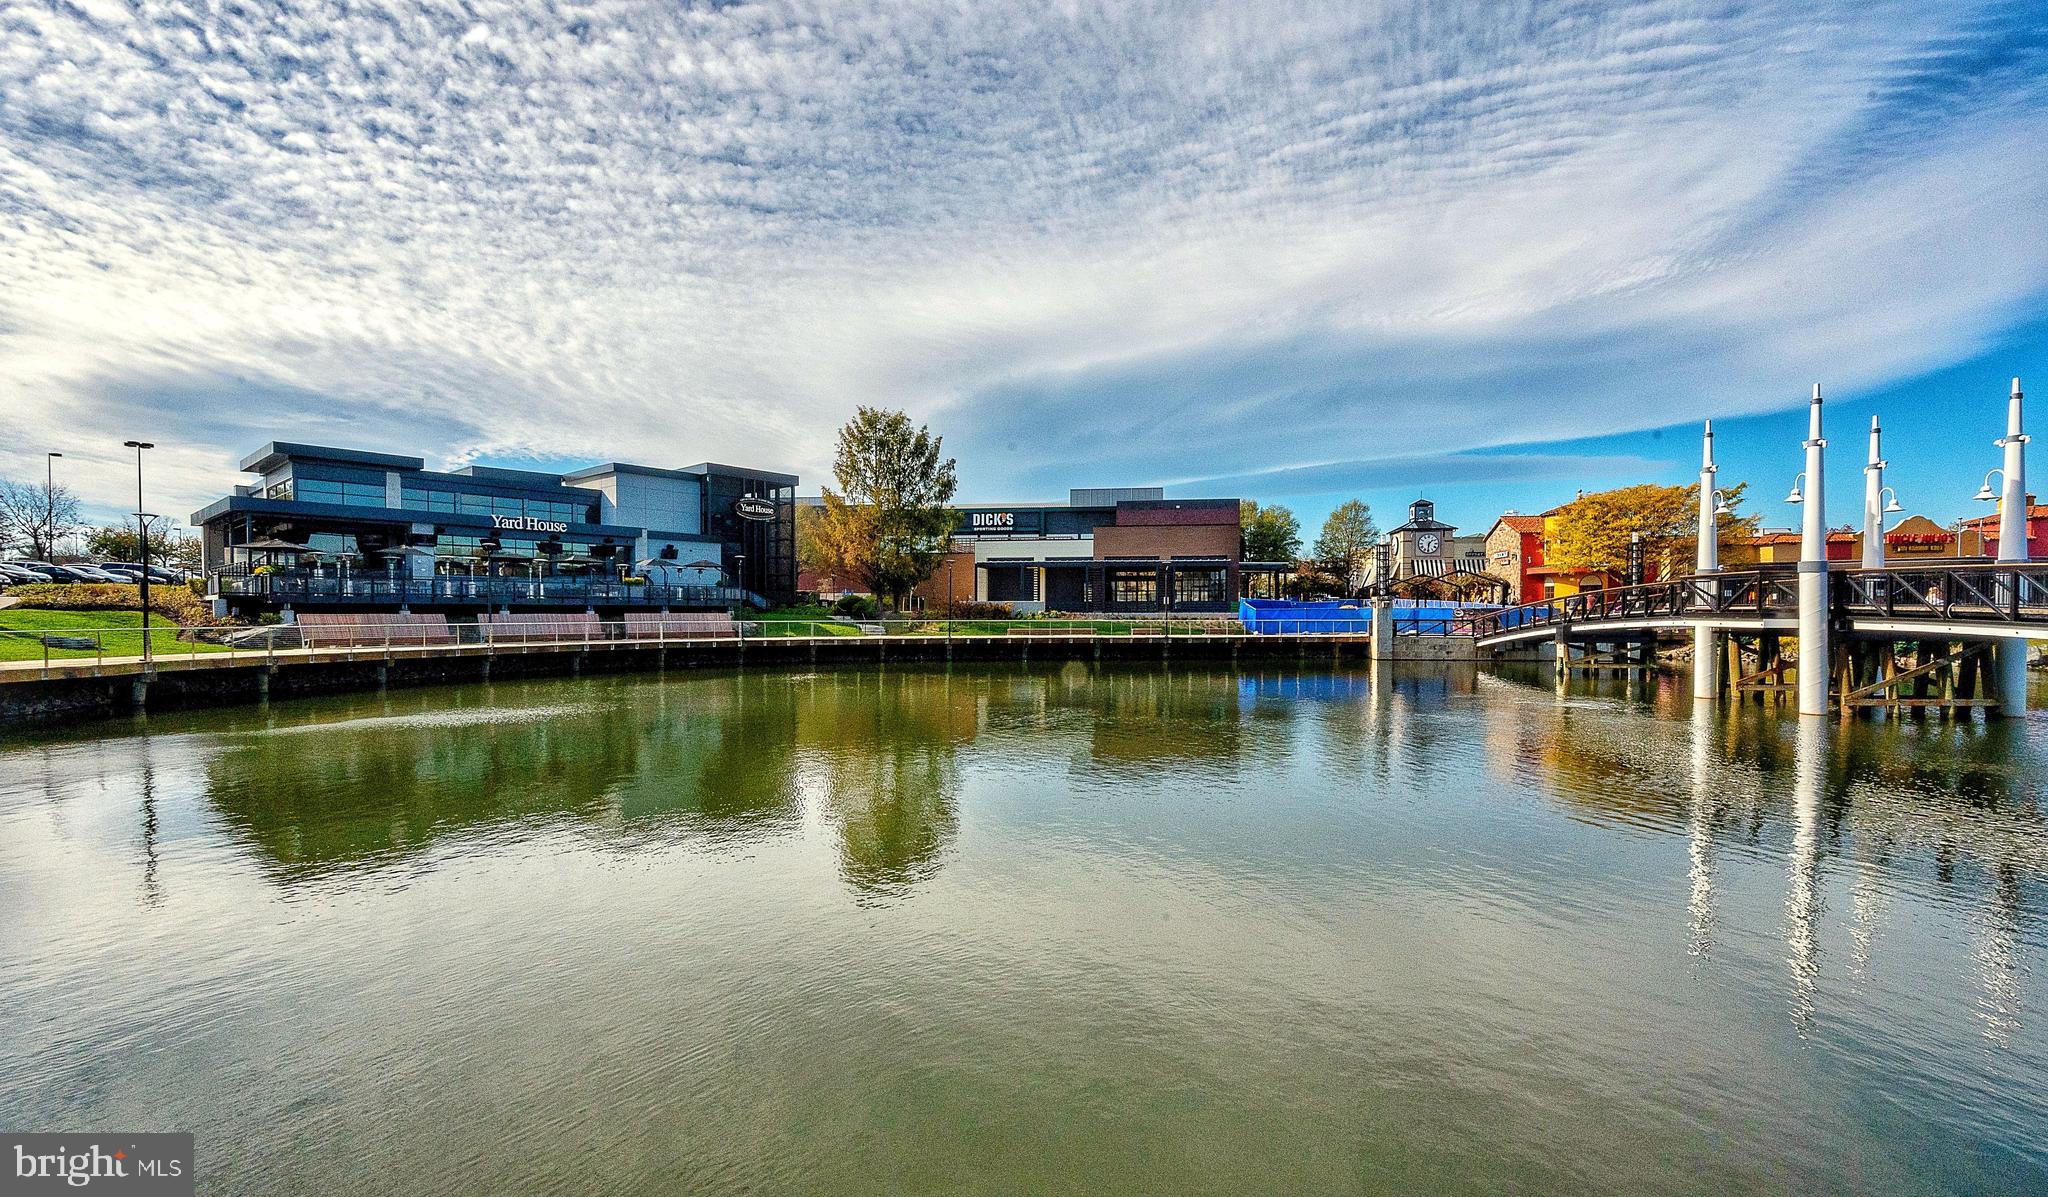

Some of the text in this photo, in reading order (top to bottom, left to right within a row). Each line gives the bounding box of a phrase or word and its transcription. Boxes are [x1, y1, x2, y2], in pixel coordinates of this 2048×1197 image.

[740, 503, 774, 514] Yard House
[491, 514, 568, 533] Yard House
